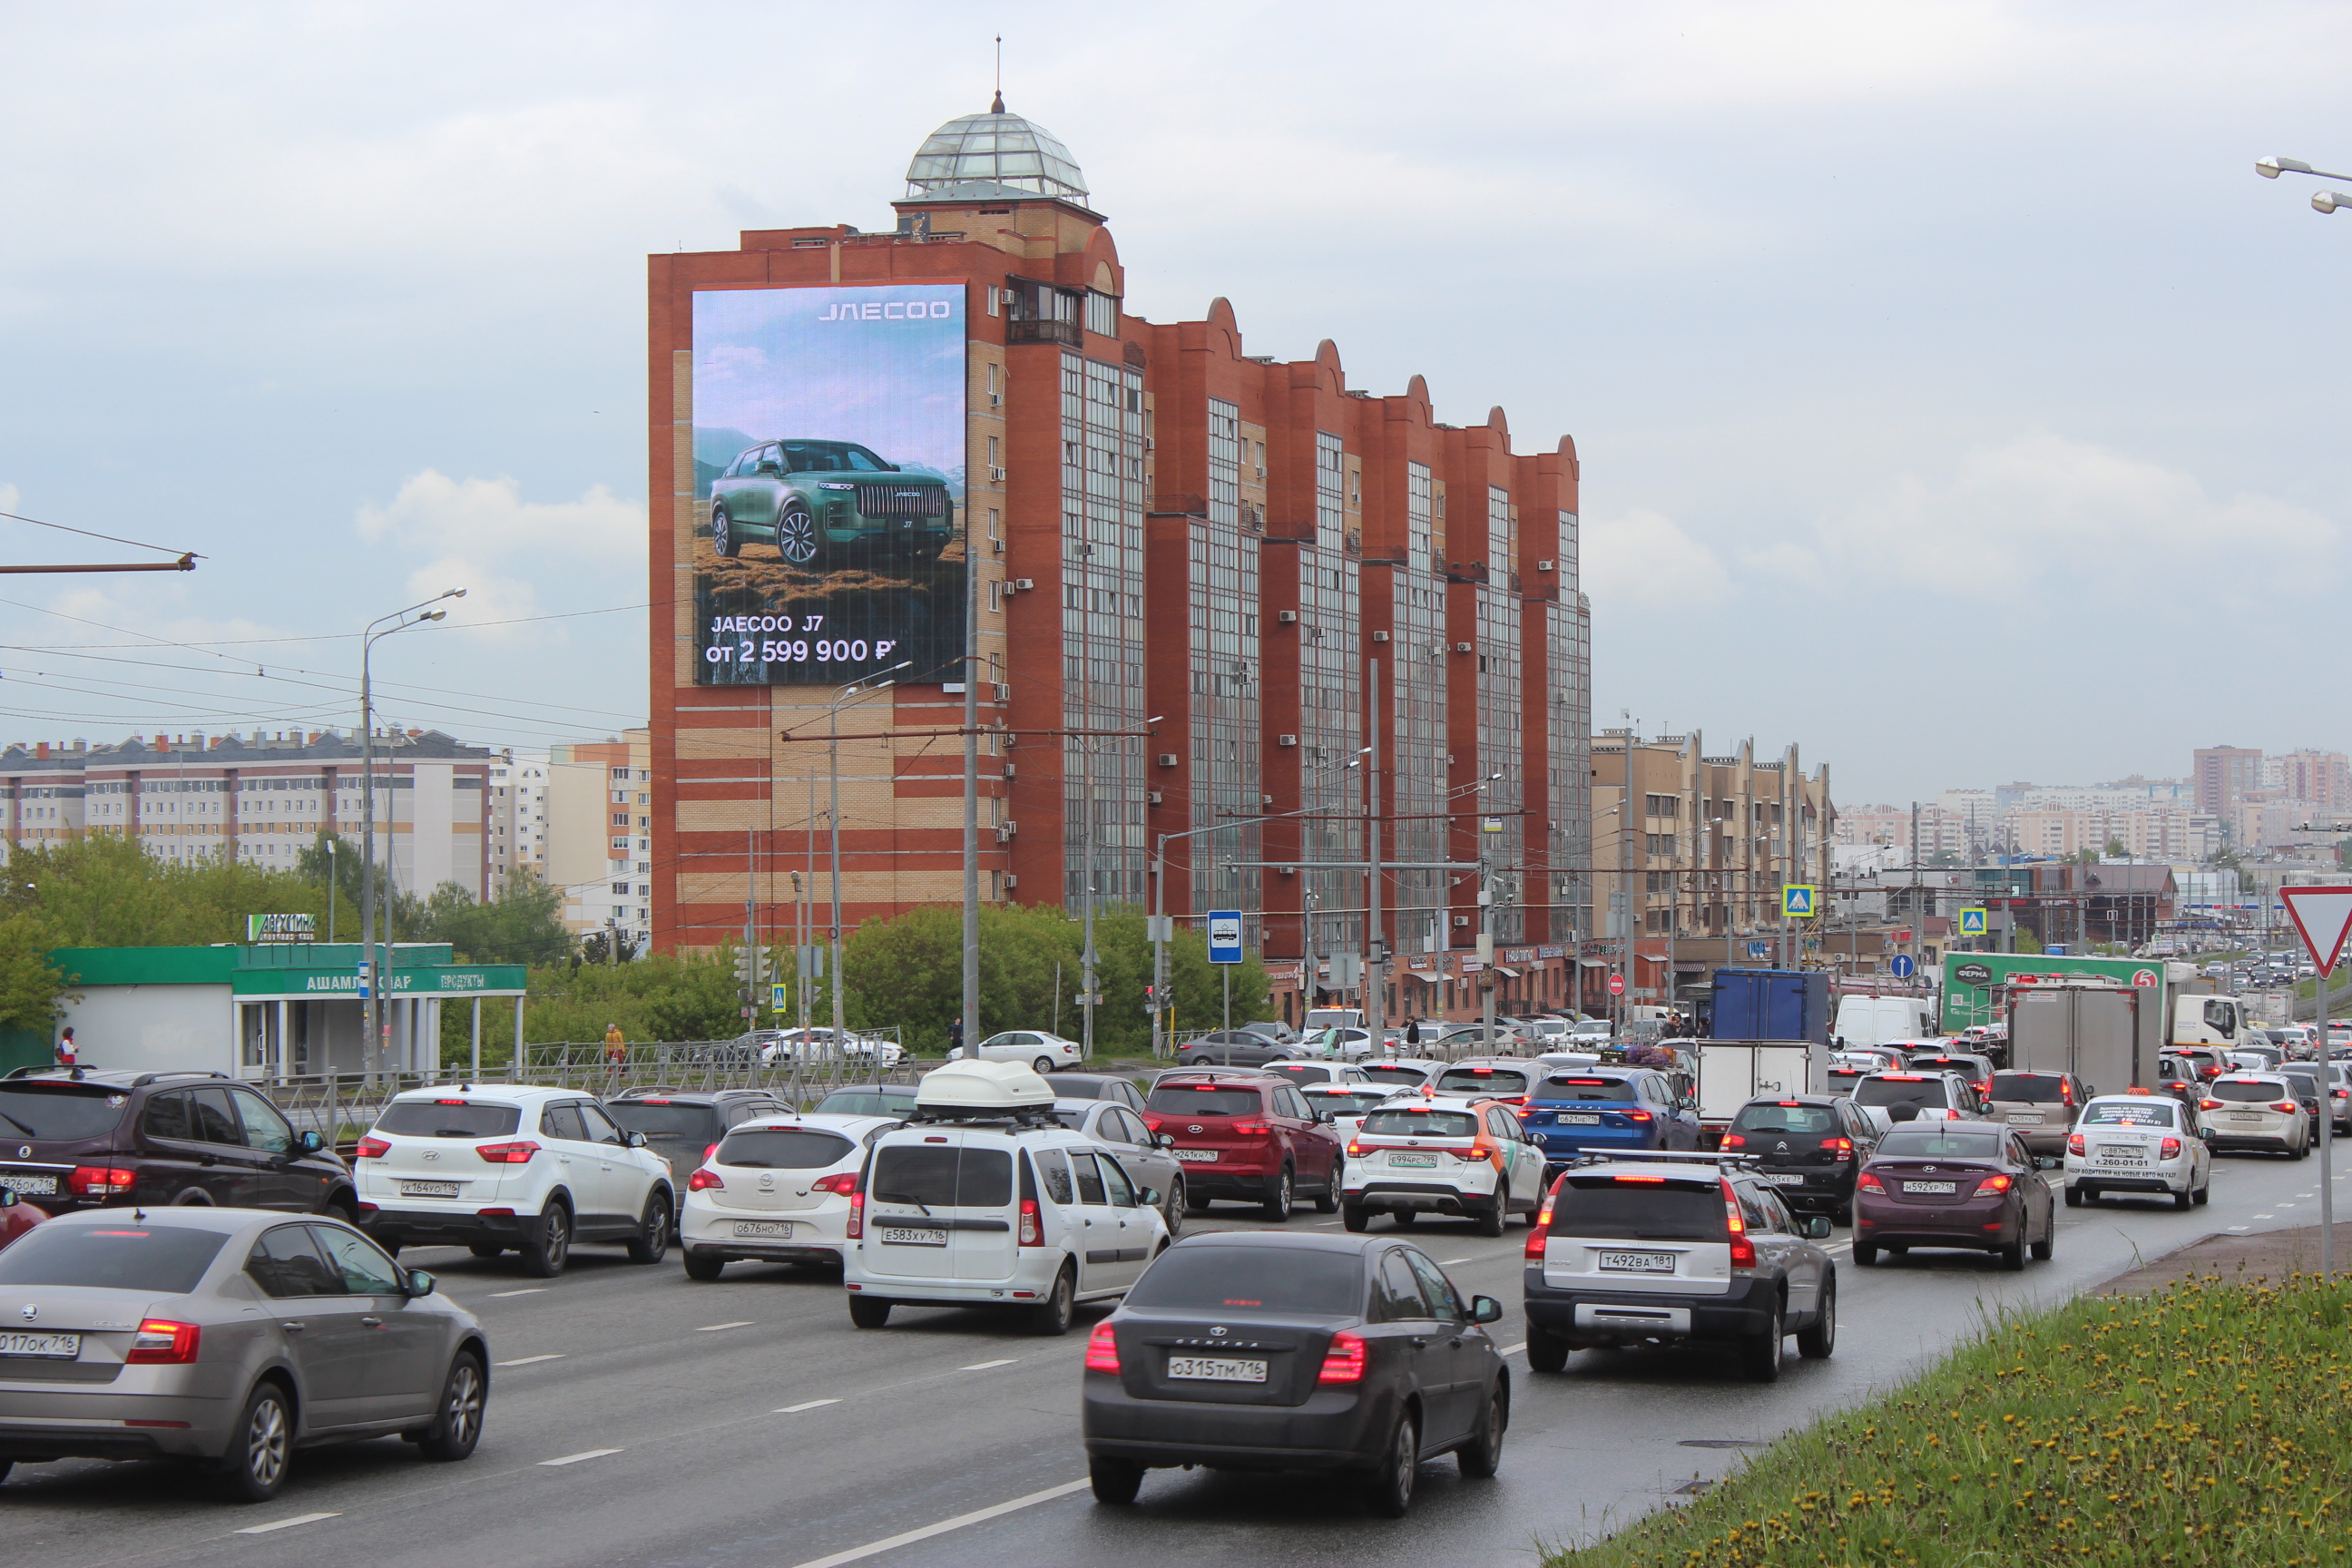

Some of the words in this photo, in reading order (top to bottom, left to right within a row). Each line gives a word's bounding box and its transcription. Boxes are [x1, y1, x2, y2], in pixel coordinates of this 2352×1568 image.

[818, 301, 950, 321] JAECOO
[903, 520, 913, 528] J7
[710, 615, 793, 632] JAECOO
[802, 615, 824, 632] J7
[739, 641, 756, 662] 2
[760, 640, 808, 662] 599
[816, 639, 868, 662] 900
[1958, 970, 1988, 978] ФЕРМА
[440, 974, 485, 990] ПРОДУКТЫ
[1391, 1155, 1421, 1164] Е994РС
[2082, 1168, 2112, 1176] ВОДИТЕЛЕЙ
[0, 1179, 36, 1190] 826ОК
[39, 1179, 54, 1189] 716
[404, 1183, 441, 1193] Х164УО
[1906, 1182, 1939, 1191] Н592ХР
[1940, 1182, 1954, 1191] 716
[873, 1207, 918, 1215] LADA
[737, 1222, 774, 1234] О676НО
[775, 1223, 789, 1232] 716
[886, 1229, 926, 1241] Е583ХУ
[927, 1230, 944, 1240] 716
[1605, 1254, 1651, 1268] Т492ВА
[1652, 1255, 1671, 1266] 181
[52, 1336, 74, 1349] 716
[1176, 1338, 1259, 1348] GENTRA
[1174, 1359, 1236, 1378] О315ТМ
[1239, 1361, 1261, 1375] 716
